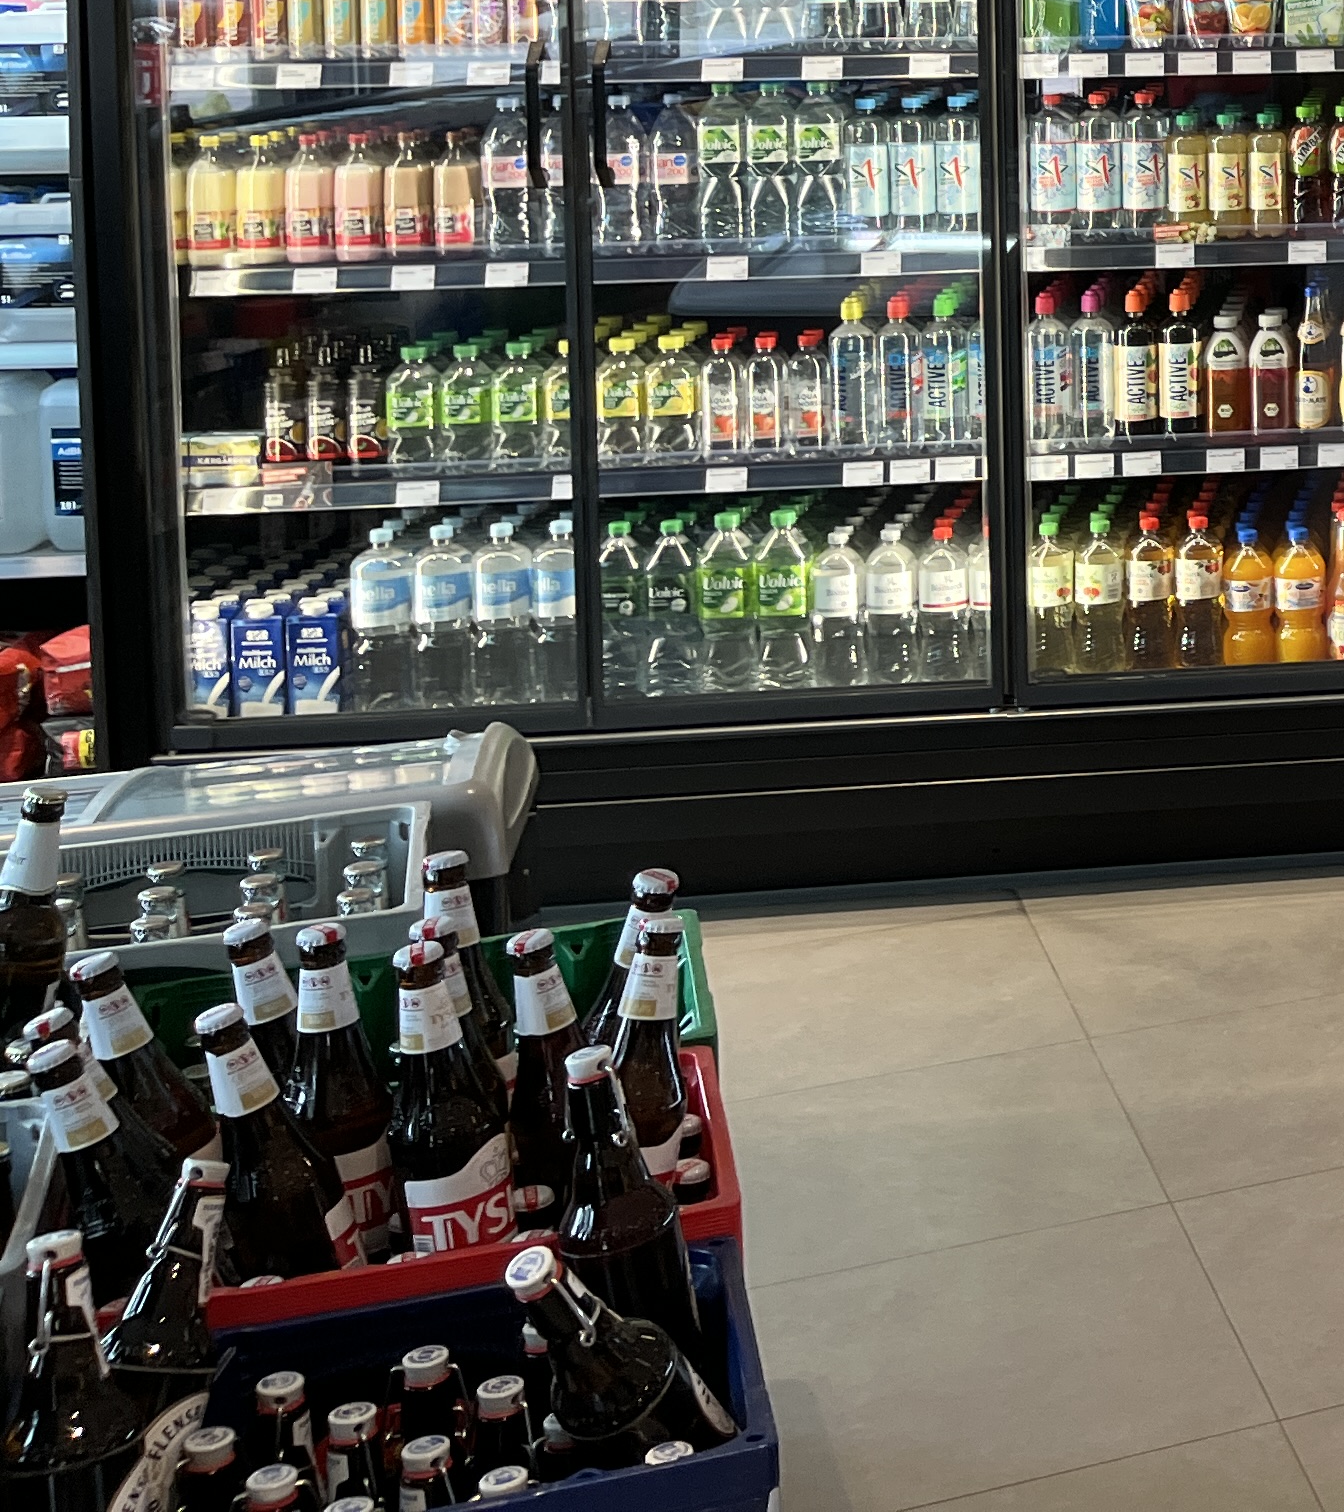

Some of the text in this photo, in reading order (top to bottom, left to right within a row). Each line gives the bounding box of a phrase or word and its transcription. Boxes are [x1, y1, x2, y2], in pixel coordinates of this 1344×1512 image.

[926, 361, 946, 410] ACTIVE
[238, 654, 276, 671] Milch
[293, 652, 332, 669] Milch
